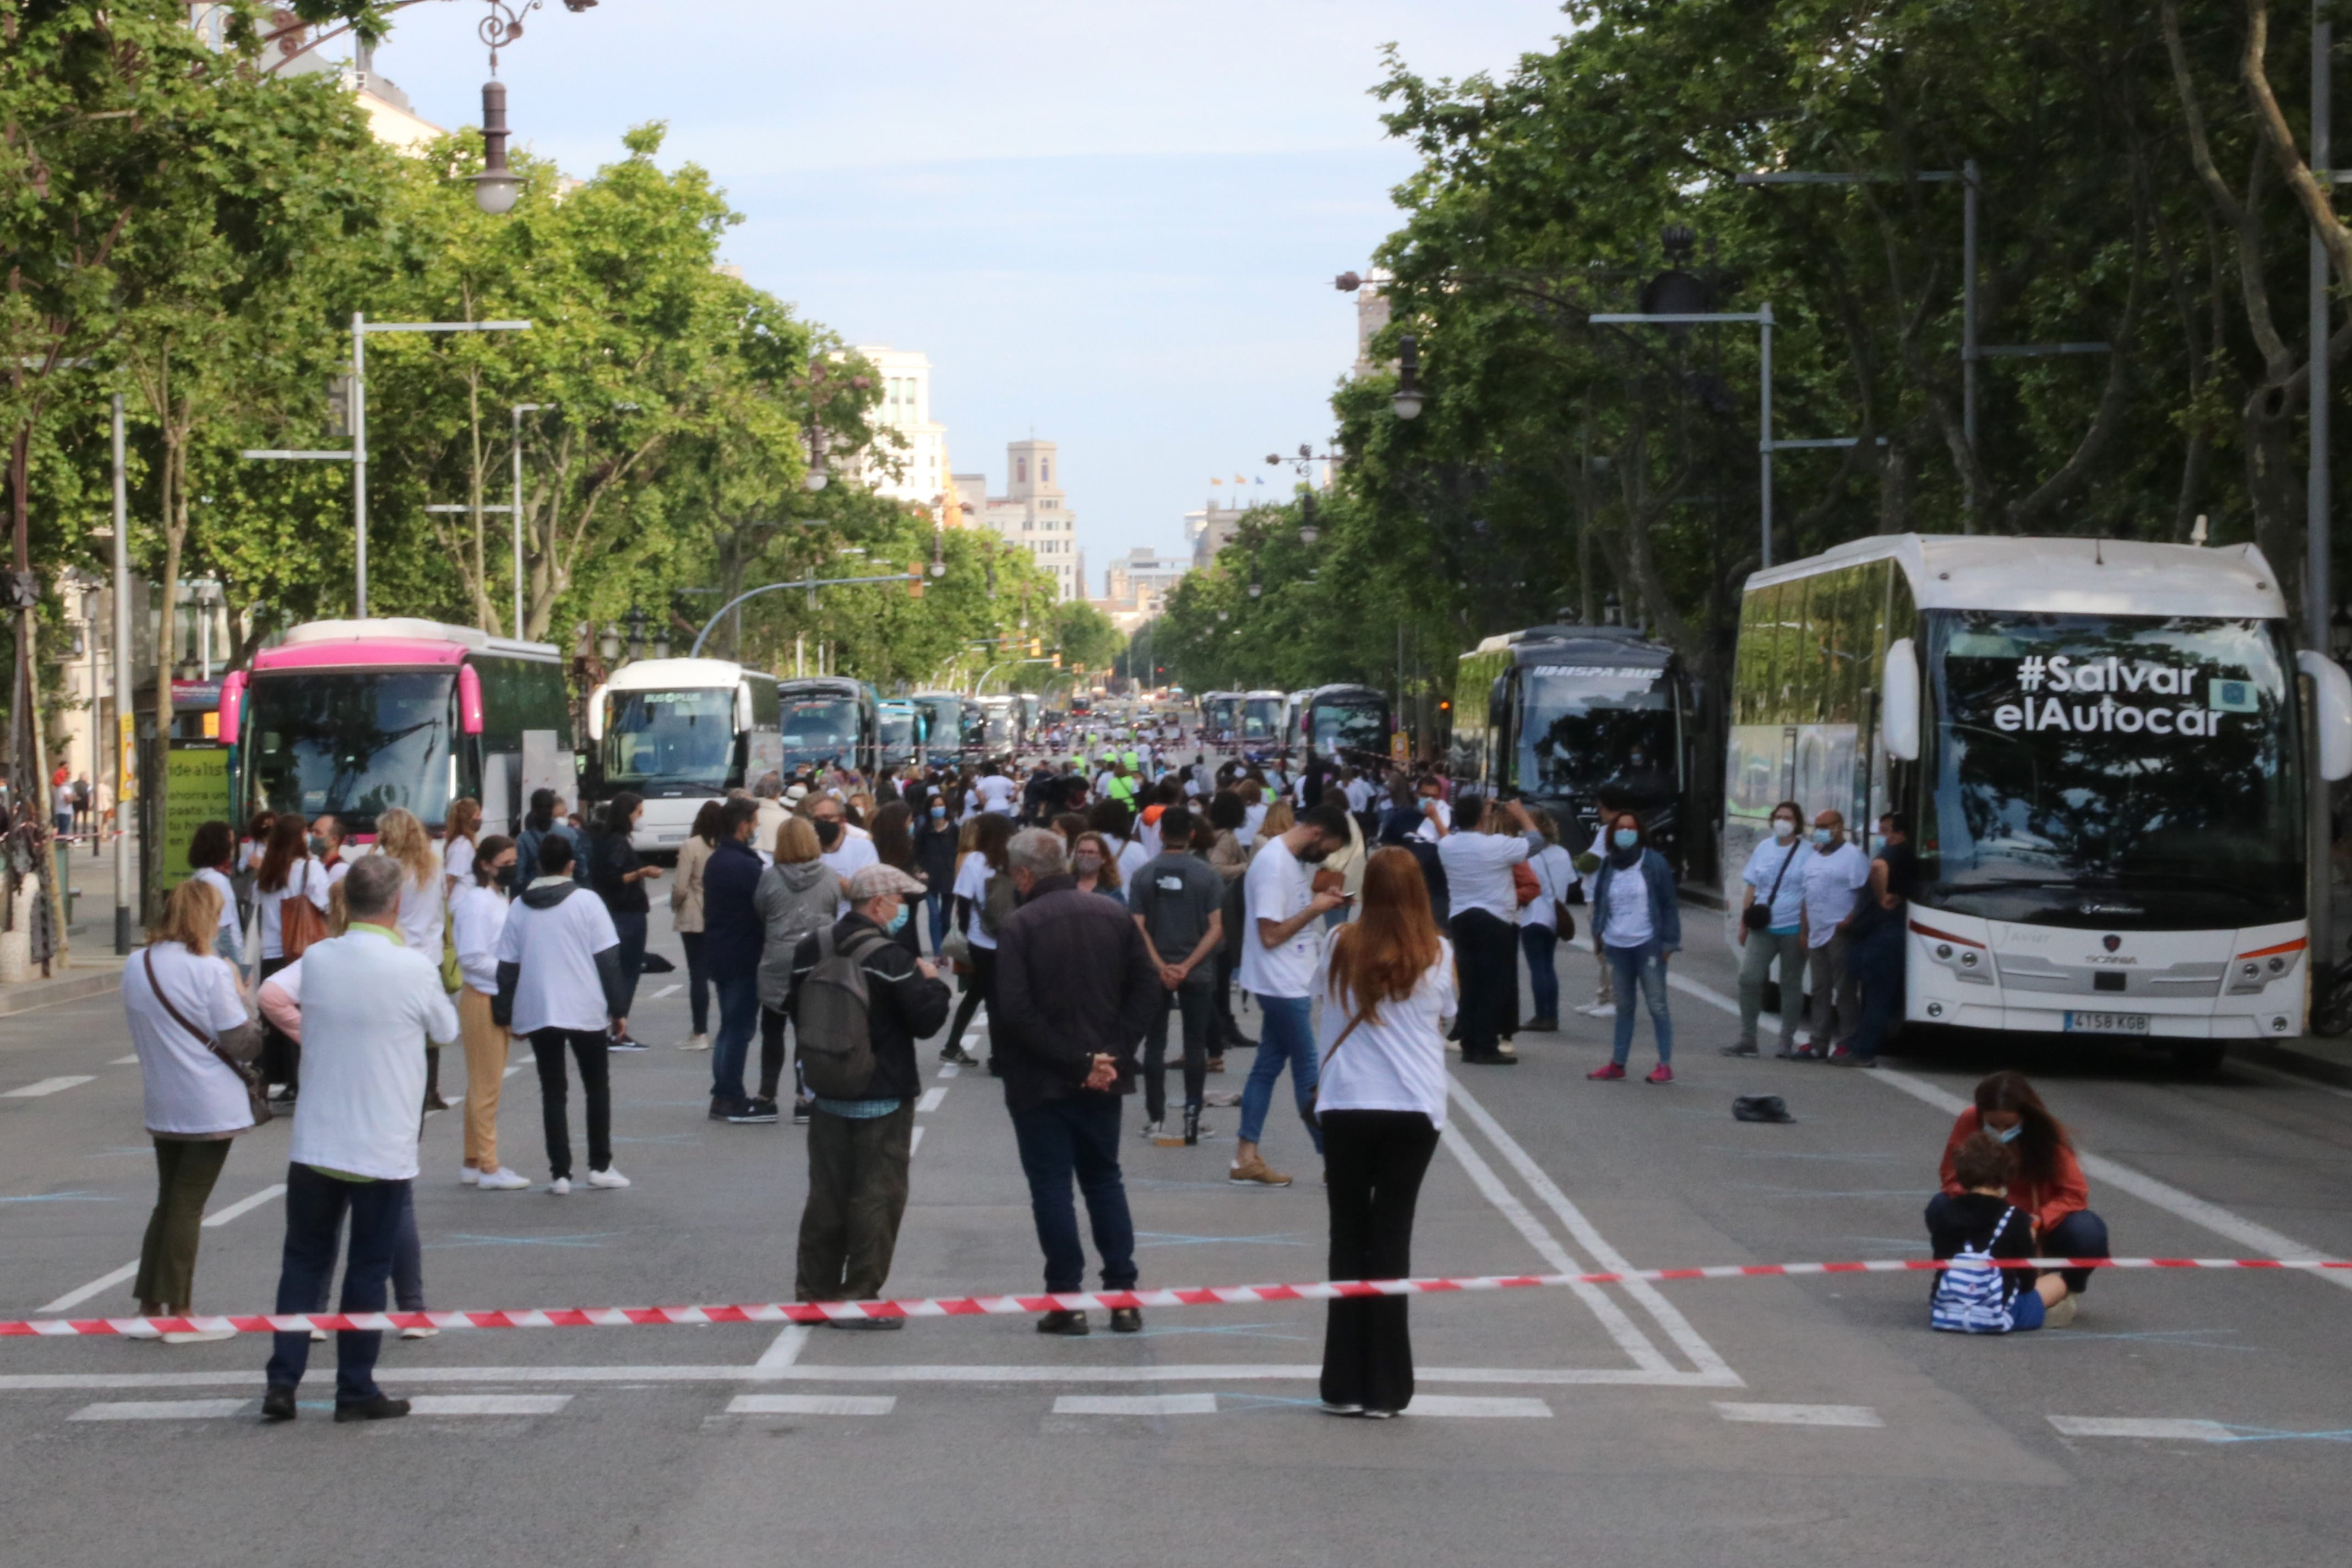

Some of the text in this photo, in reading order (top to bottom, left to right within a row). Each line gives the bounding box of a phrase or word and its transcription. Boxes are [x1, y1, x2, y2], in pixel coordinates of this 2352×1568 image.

[2017, 655, 2198, 695] #Salvar
[1994, 696, 2224, 737] elAutocar
[2075, 1014, 2146, 1030] 4158 KGB
